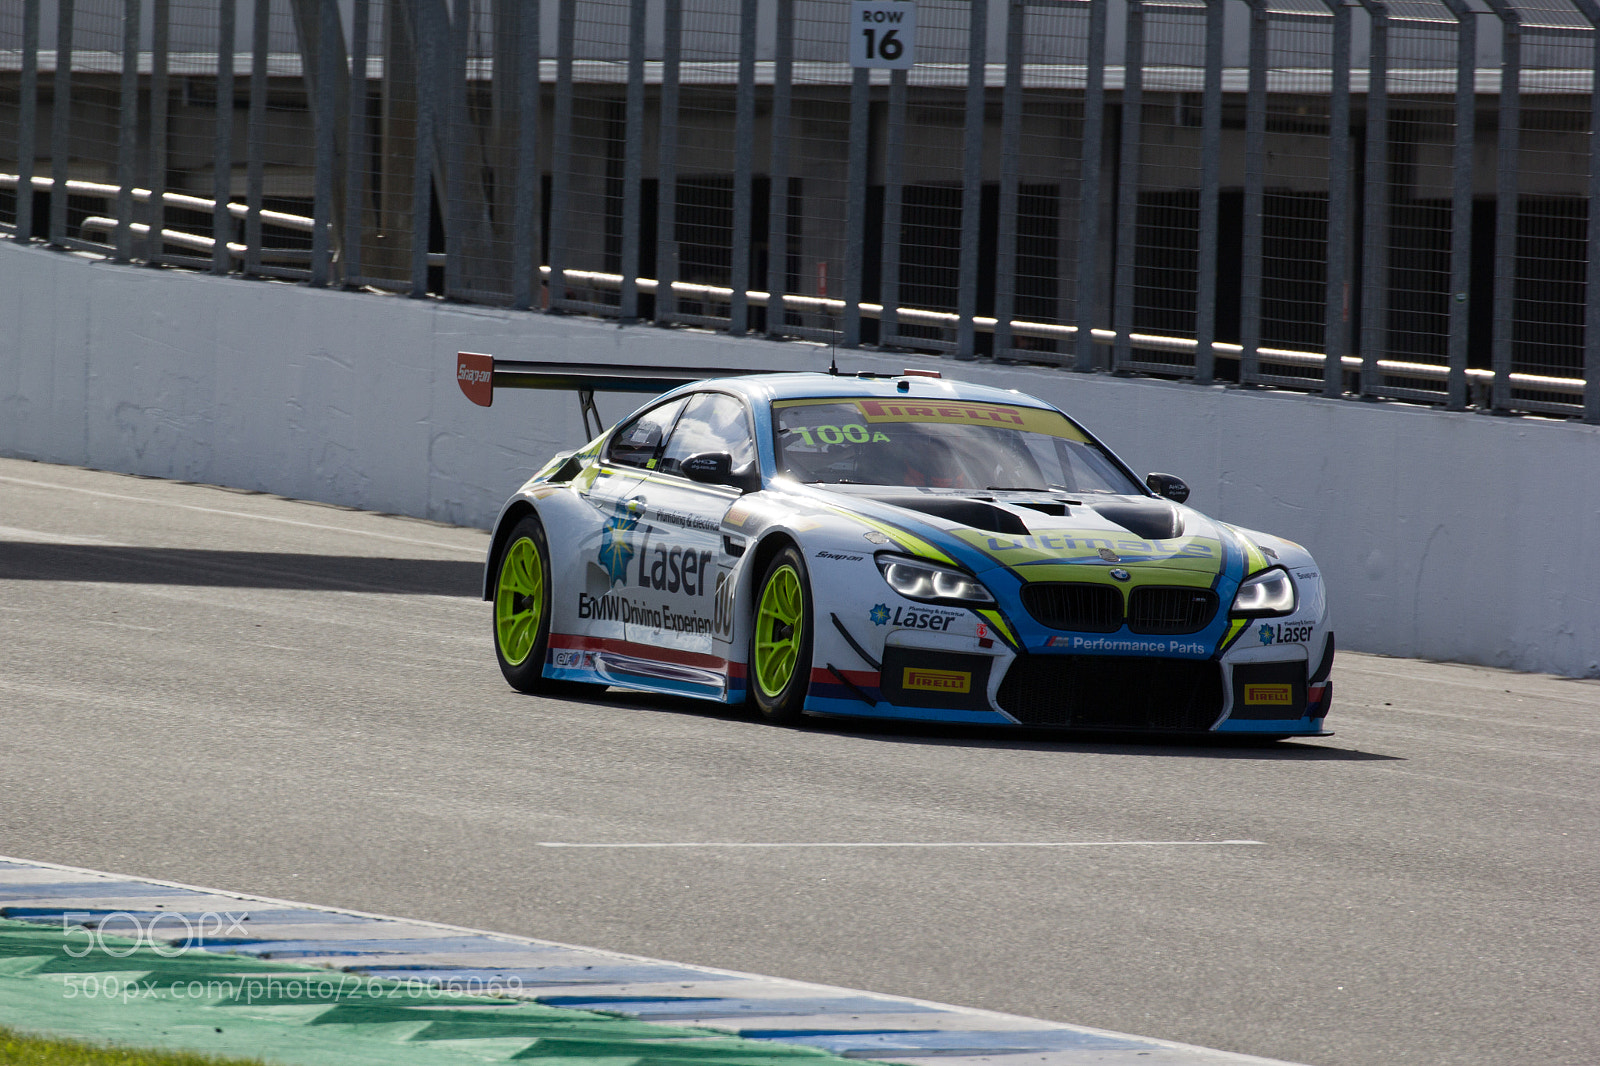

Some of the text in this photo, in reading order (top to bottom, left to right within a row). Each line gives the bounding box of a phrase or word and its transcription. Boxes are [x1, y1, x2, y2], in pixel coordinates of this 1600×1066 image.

[862, 10, 904, 23] ROW
[862, 29, 904, 60] 16
[457, 364, 491, 385] Snap-on
[860, 400, 1024, 426] PIRELLI
[638, 525, 712, 597] Laser
[578, 593, 619, 621] BMW
[621, 597, 662, 636] Driving
[892, 606, 956, 631] Laser
[1276, 623, 1313, 643] Laser
[1073, 636, 1165, 652] Performance
[1169, 640, 1205, 654] Parts
[908, 671, 965, 689] PIRELLI
[1249, 688, 1289, 701] PIRELLI
